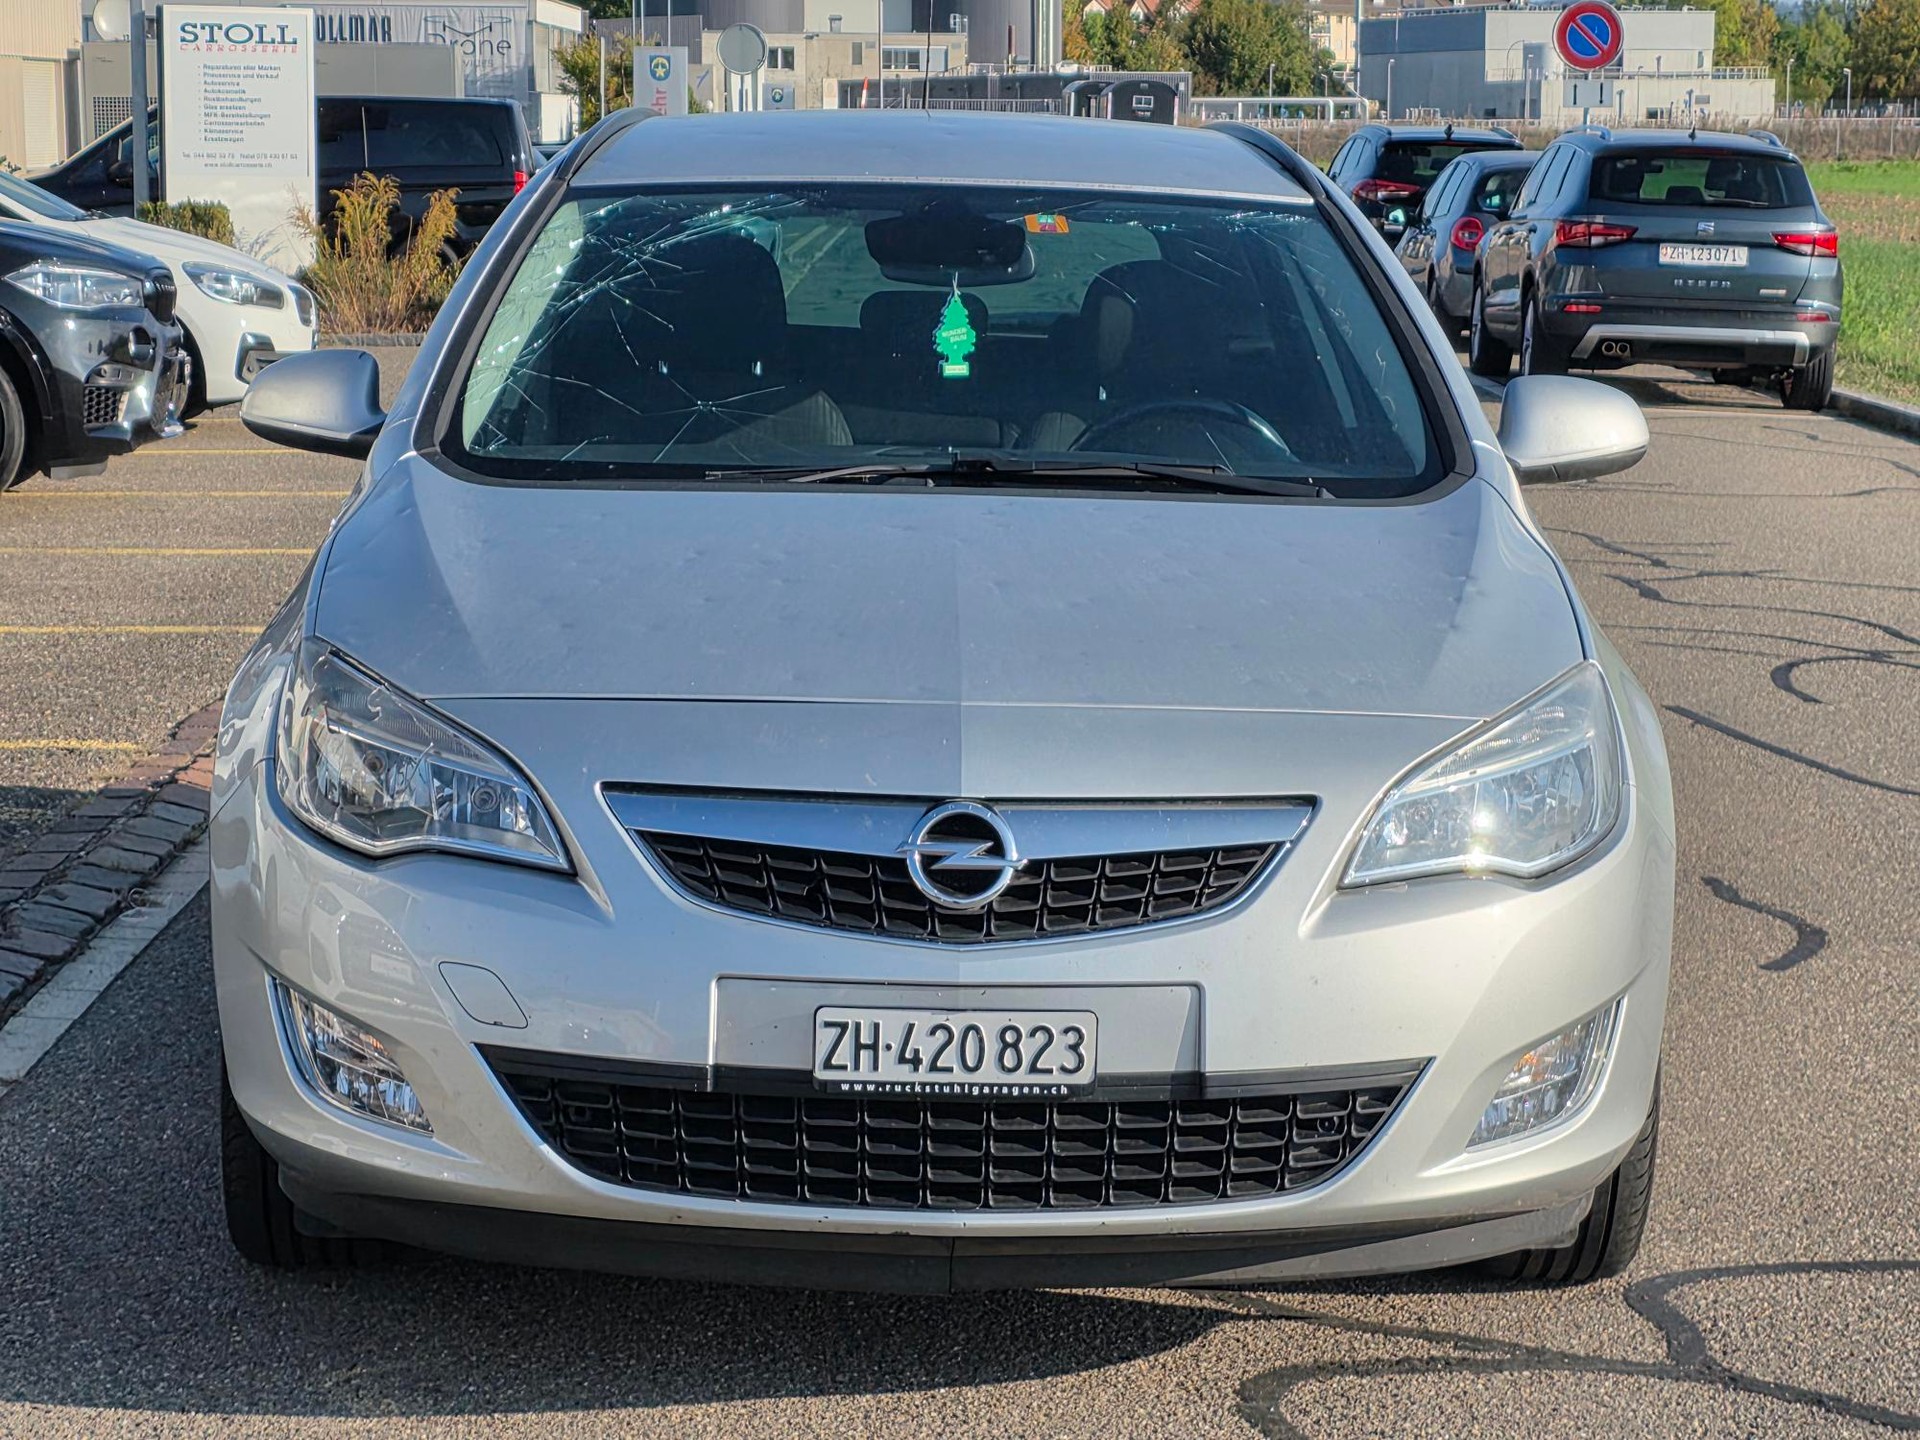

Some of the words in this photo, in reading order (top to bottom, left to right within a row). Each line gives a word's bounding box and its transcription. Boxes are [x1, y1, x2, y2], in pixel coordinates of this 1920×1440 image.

[180, 22, 298, 45] STOLL
[316, 14, 392, 42] OLLMAR
[180, 44, 298, 53] CARROSSERIE
[203, 63, 242, 72] Reparaturen
[651, 86, 667, 115] ehr
[997, 1022, 1087, 1076] 823
[840, 1082, 1069, 1096] www.ruckstuhlgaragen.ch
